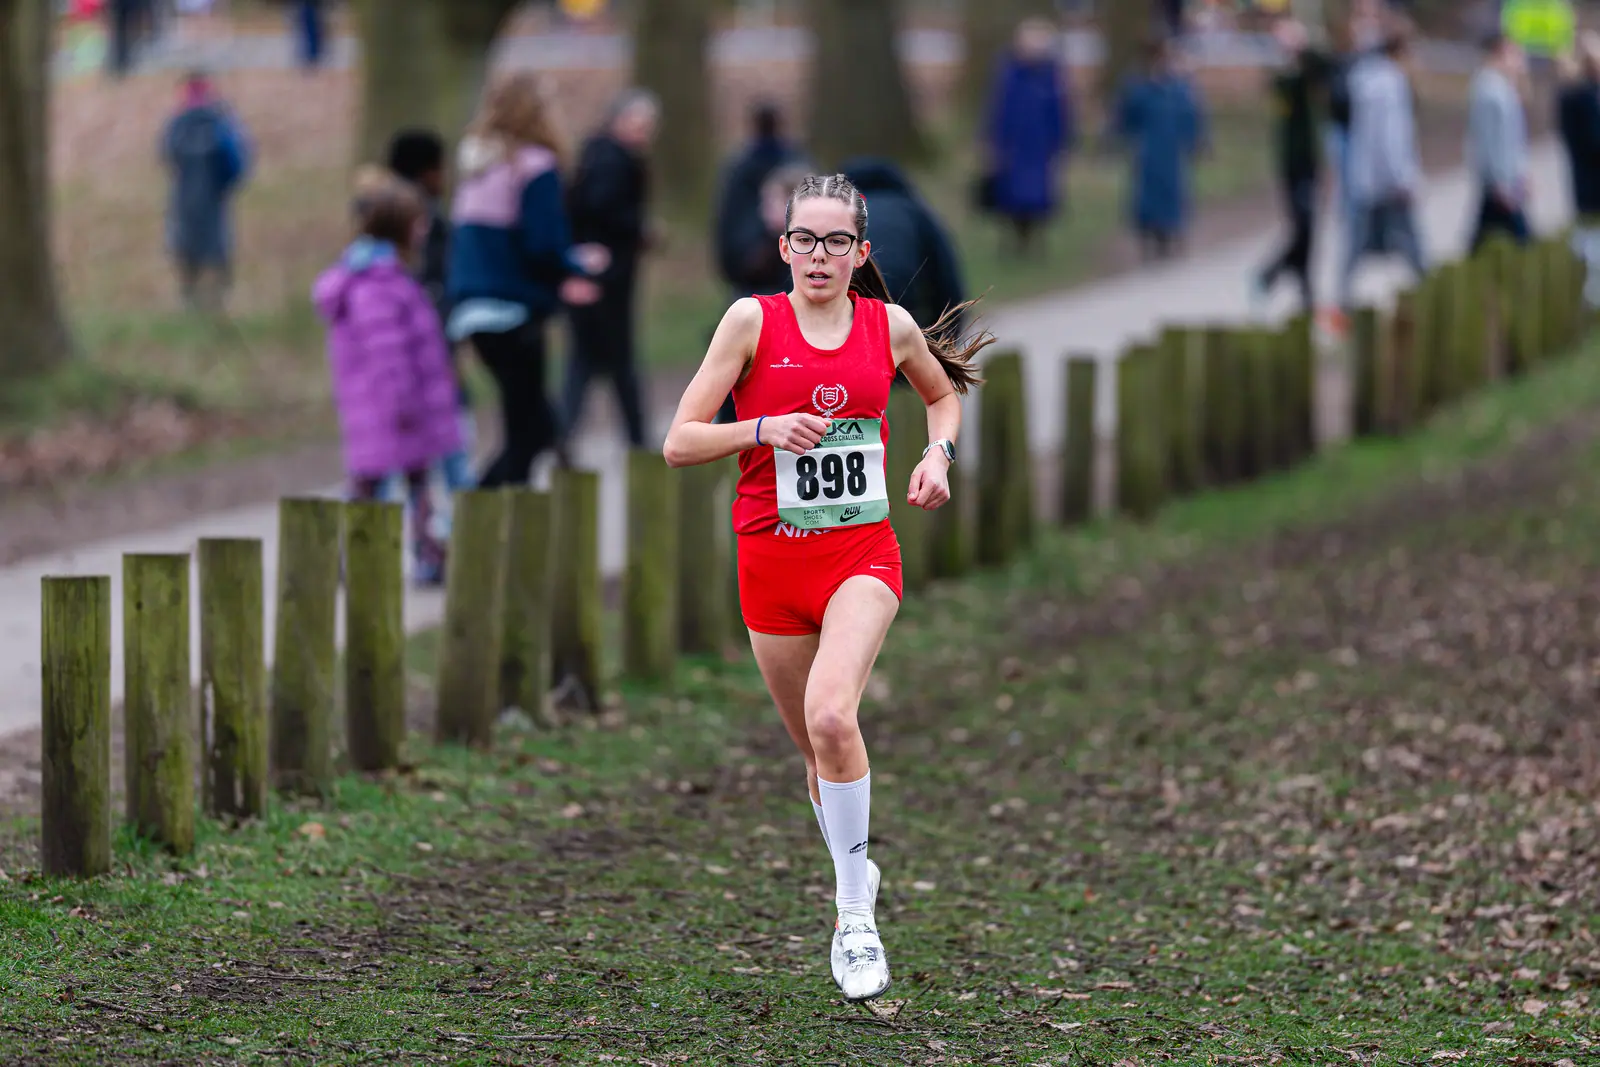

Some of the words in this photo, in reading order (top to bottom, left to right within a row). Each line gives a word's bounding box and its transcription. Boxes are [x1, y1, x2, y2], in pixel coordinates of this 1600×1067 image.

[820, 435, 838, 443] CROSS
[838, 433, 865, 441] CHALLENGE
[795, 451, 867, 501] 898
[803, 508, 826, 516] SPORTS
[843, 505, 861, 516] RUN
